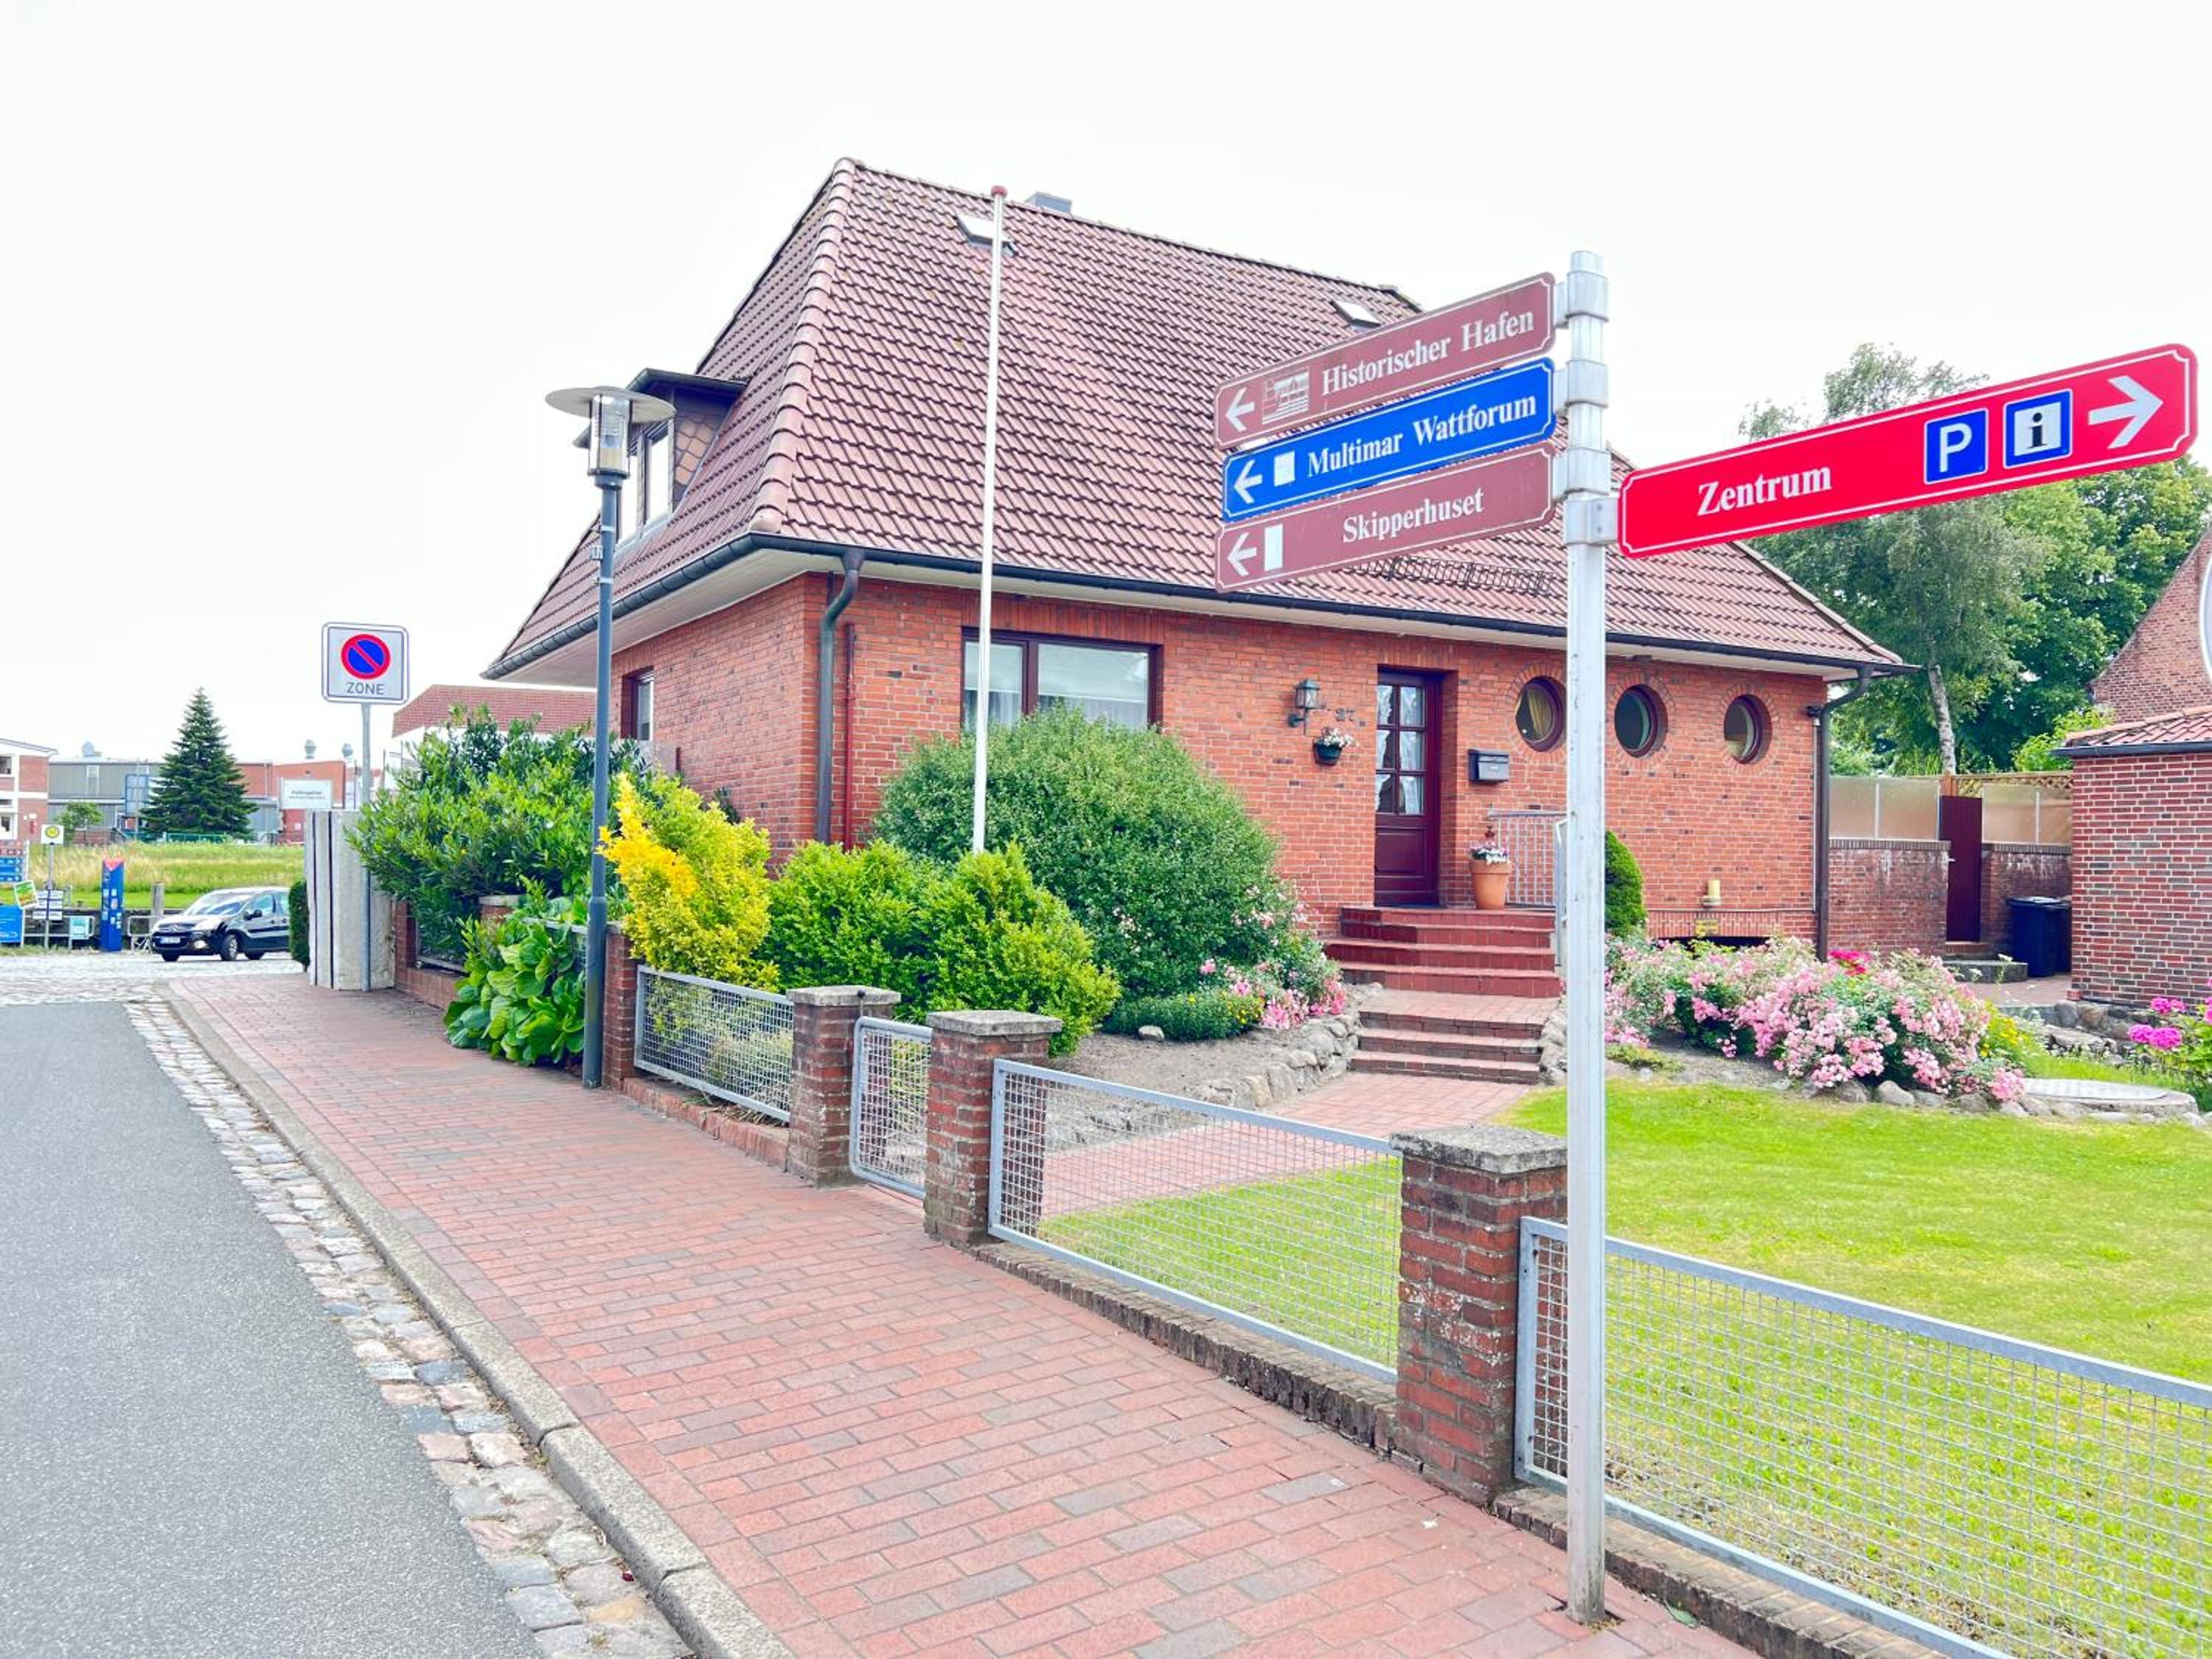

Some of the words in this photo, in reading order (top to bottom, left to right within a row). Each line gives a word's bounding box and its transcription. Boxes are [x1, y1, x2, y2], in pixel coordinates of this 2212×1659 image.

[1321, 335, 1451, 395] Historischer
[1461, 308, 1535, 352] Hafen
[1307, 430, 1402, 477] Multimar
[1413, 392, 1537, 447] Wattforum
[1697, 465, 1832, 516] Zentrum
[1939, 423, 1970, 473] P
[1342, 488, 1484, 543] Skipperhuset
[347, 683, 385, 695] ZONE
